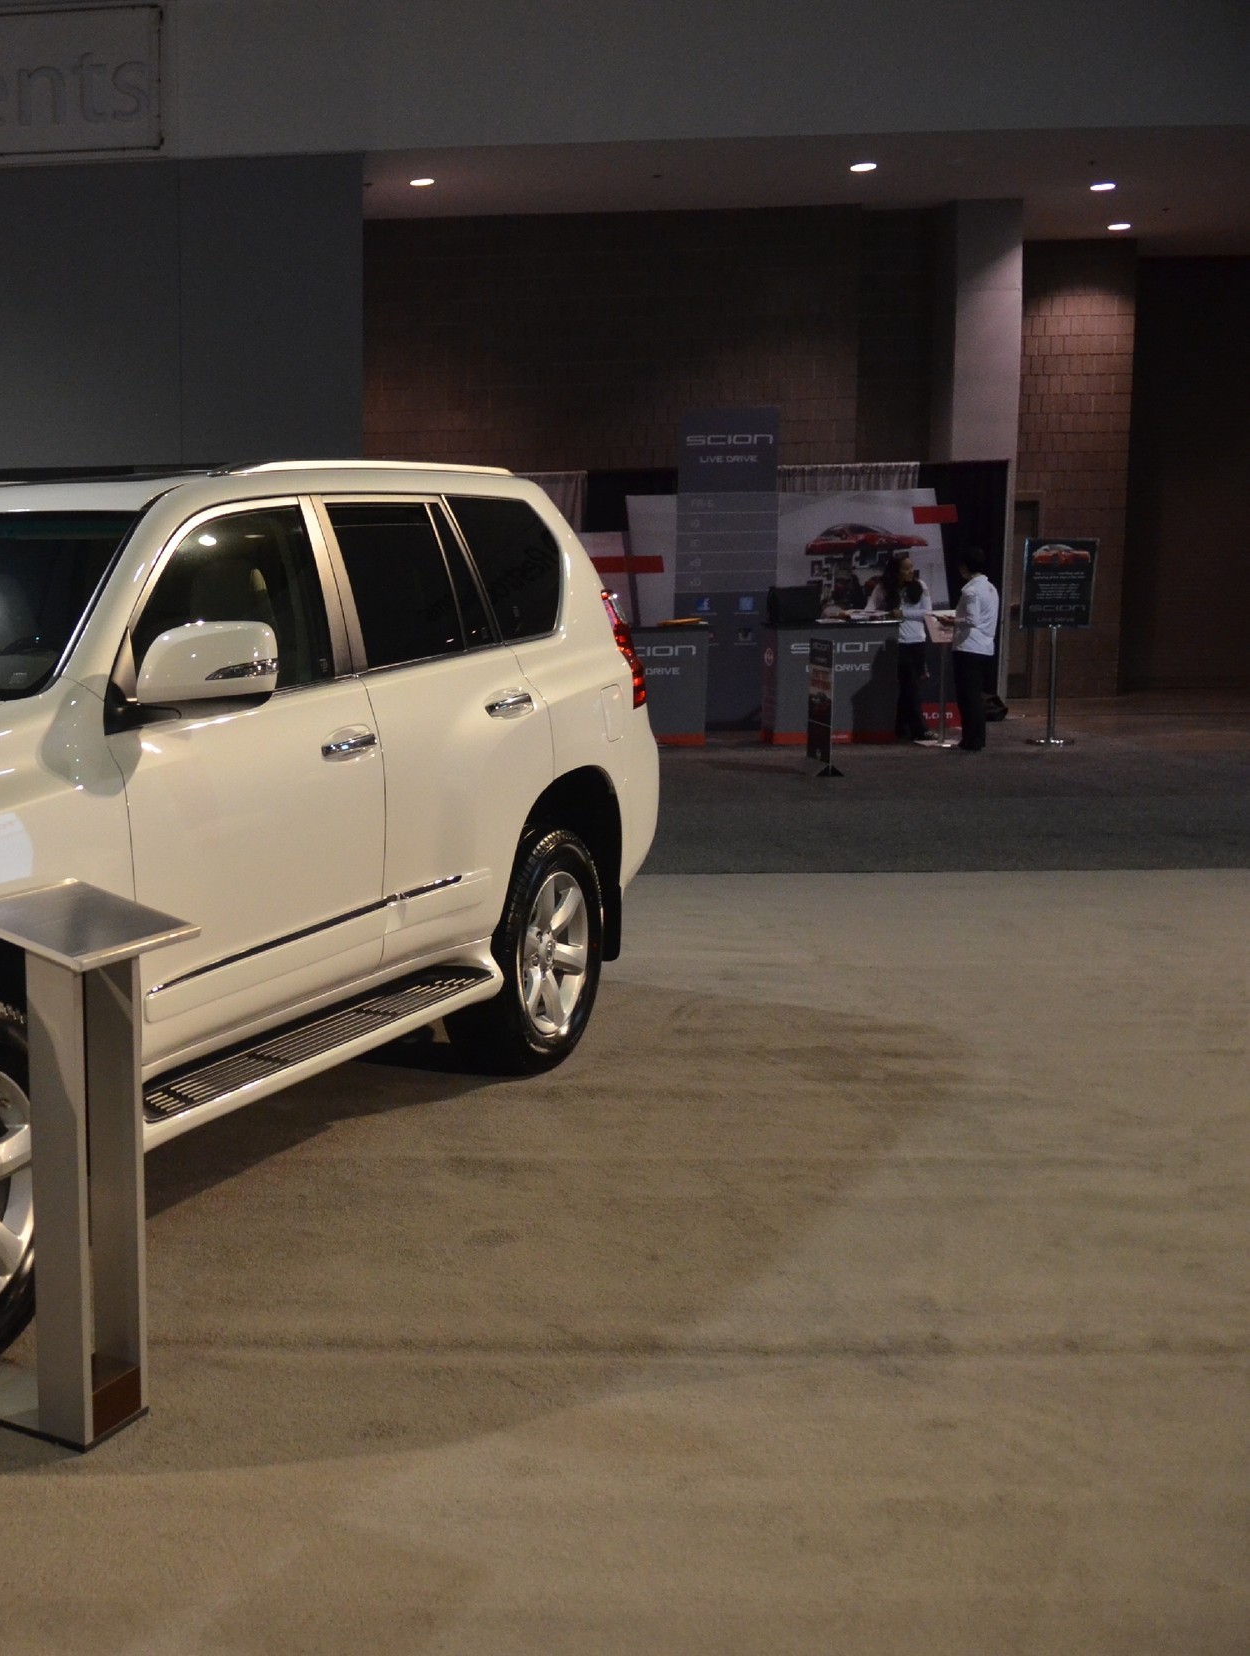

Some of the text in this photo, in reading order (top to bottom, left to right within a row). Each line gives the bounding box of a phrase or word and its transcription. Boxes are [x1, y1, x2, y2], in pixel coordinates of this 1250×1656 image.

[699, 454, 758, 464] LIVE DRIVE
[635, 645, 697, 657] CION
[790, 641, 886, 654] SION
[645, 666, 680, 675] DRIVE
[835, 663, 870, 672] DRIVE
